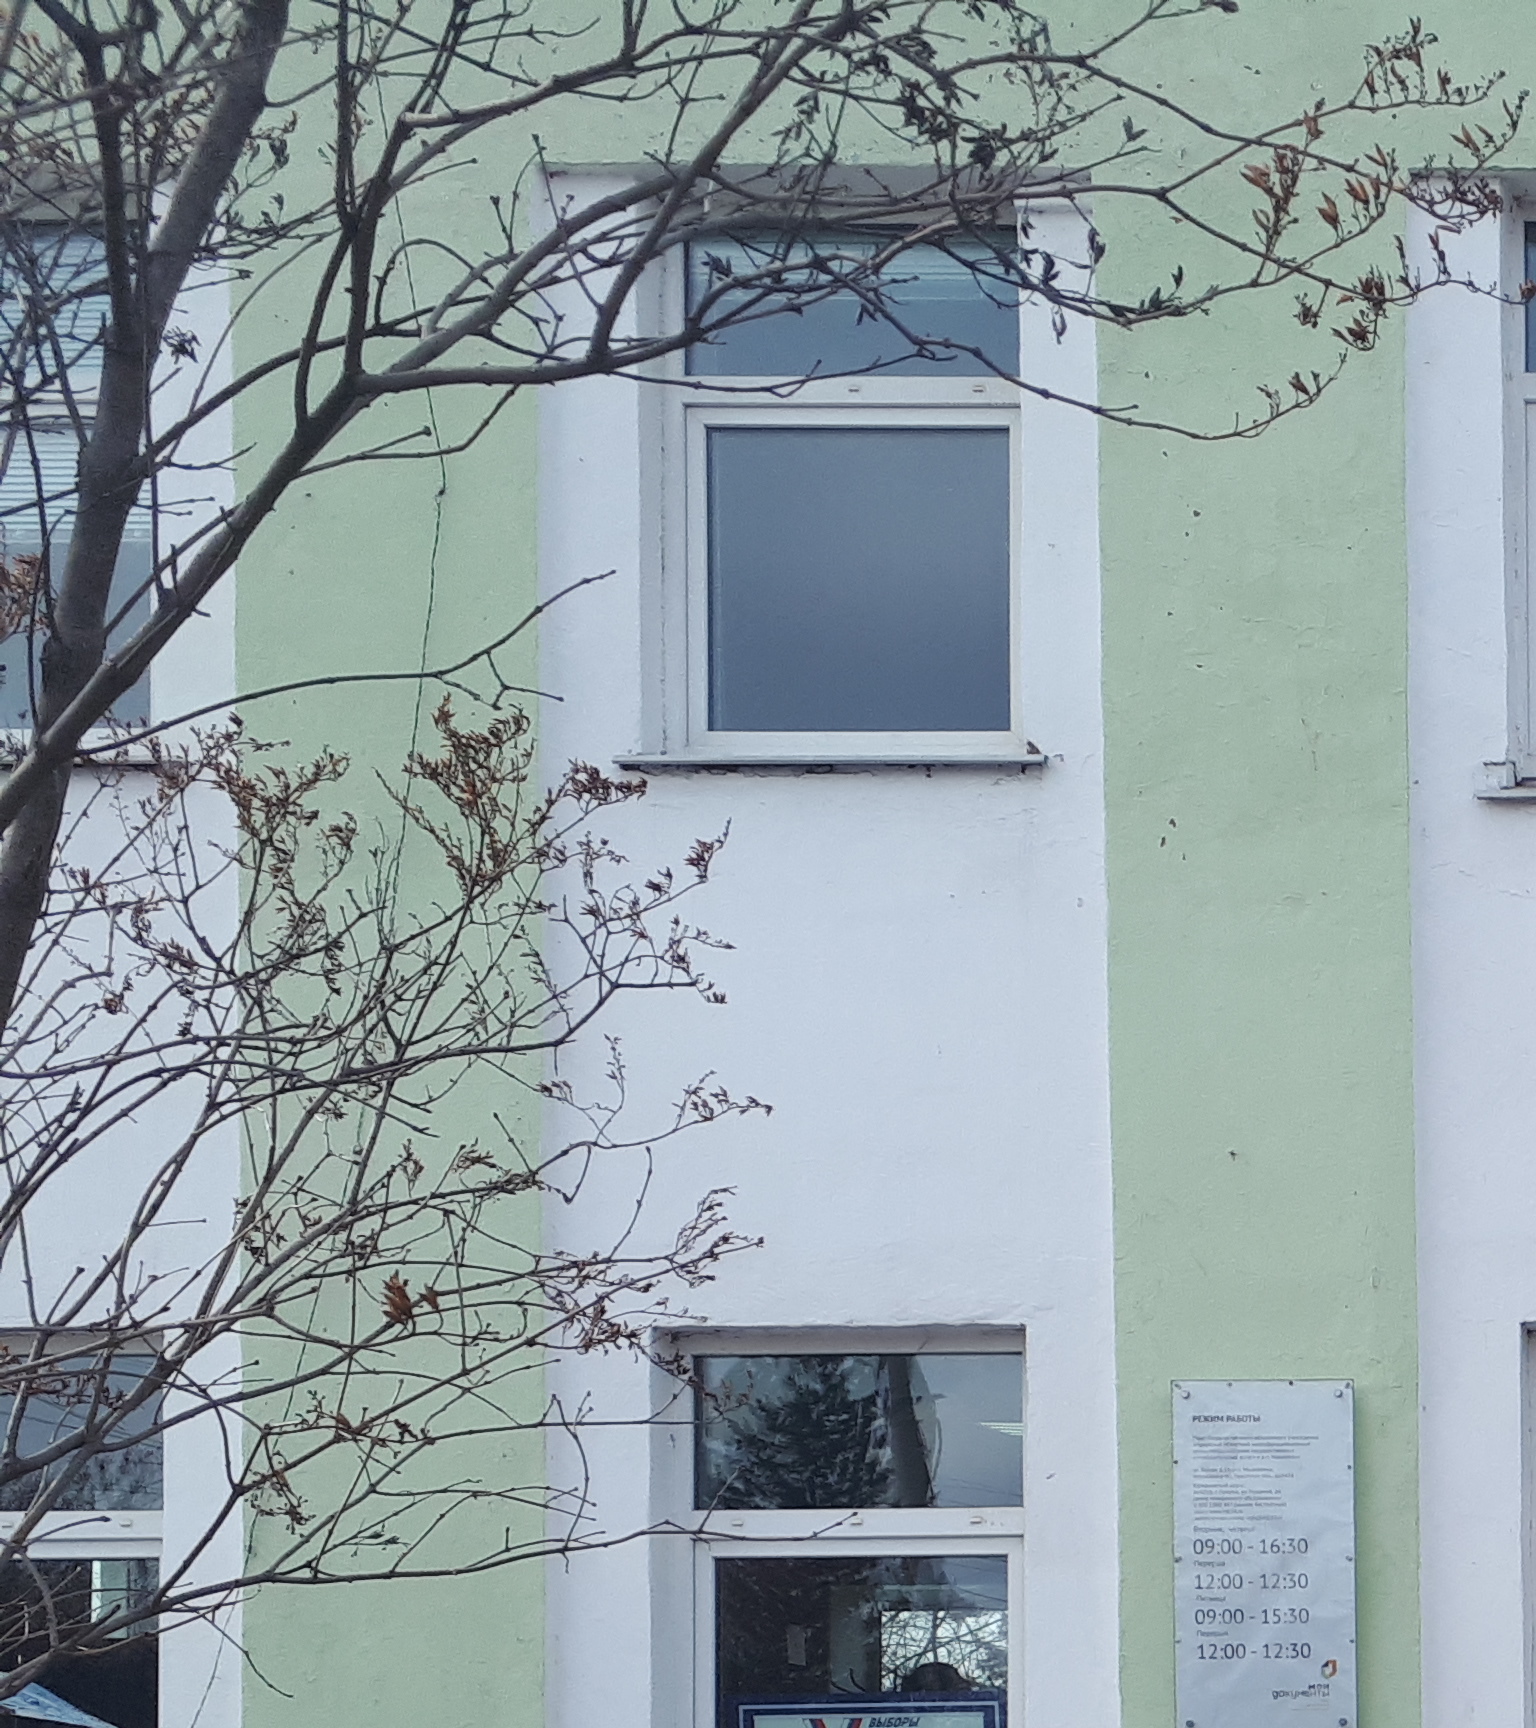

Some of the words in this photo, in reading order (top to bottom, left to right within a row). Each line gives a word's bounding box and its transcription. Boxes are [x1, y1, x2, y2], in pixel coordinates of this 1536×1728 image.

[1226, 1415, 1261, 1423] РАБОТЫ
[1193, 1538, 1243, 1555] 09:00
[1259, 1538, 1309, 1554] 16:30
[1194, 1573, 1243, 1590] 12:00
[1259, 1573, 1309, 1589] 12:30
[1194, 1609, 1245, 1625] 09:00
[1261, 1608, 1310, 1625] 15:30
[1197, 1643, 1246, 1660] 12:00
[1262, 1642, 1312, 1659] 12:30
[868, 1716, 921, 1728] ВЫБОРЫ
